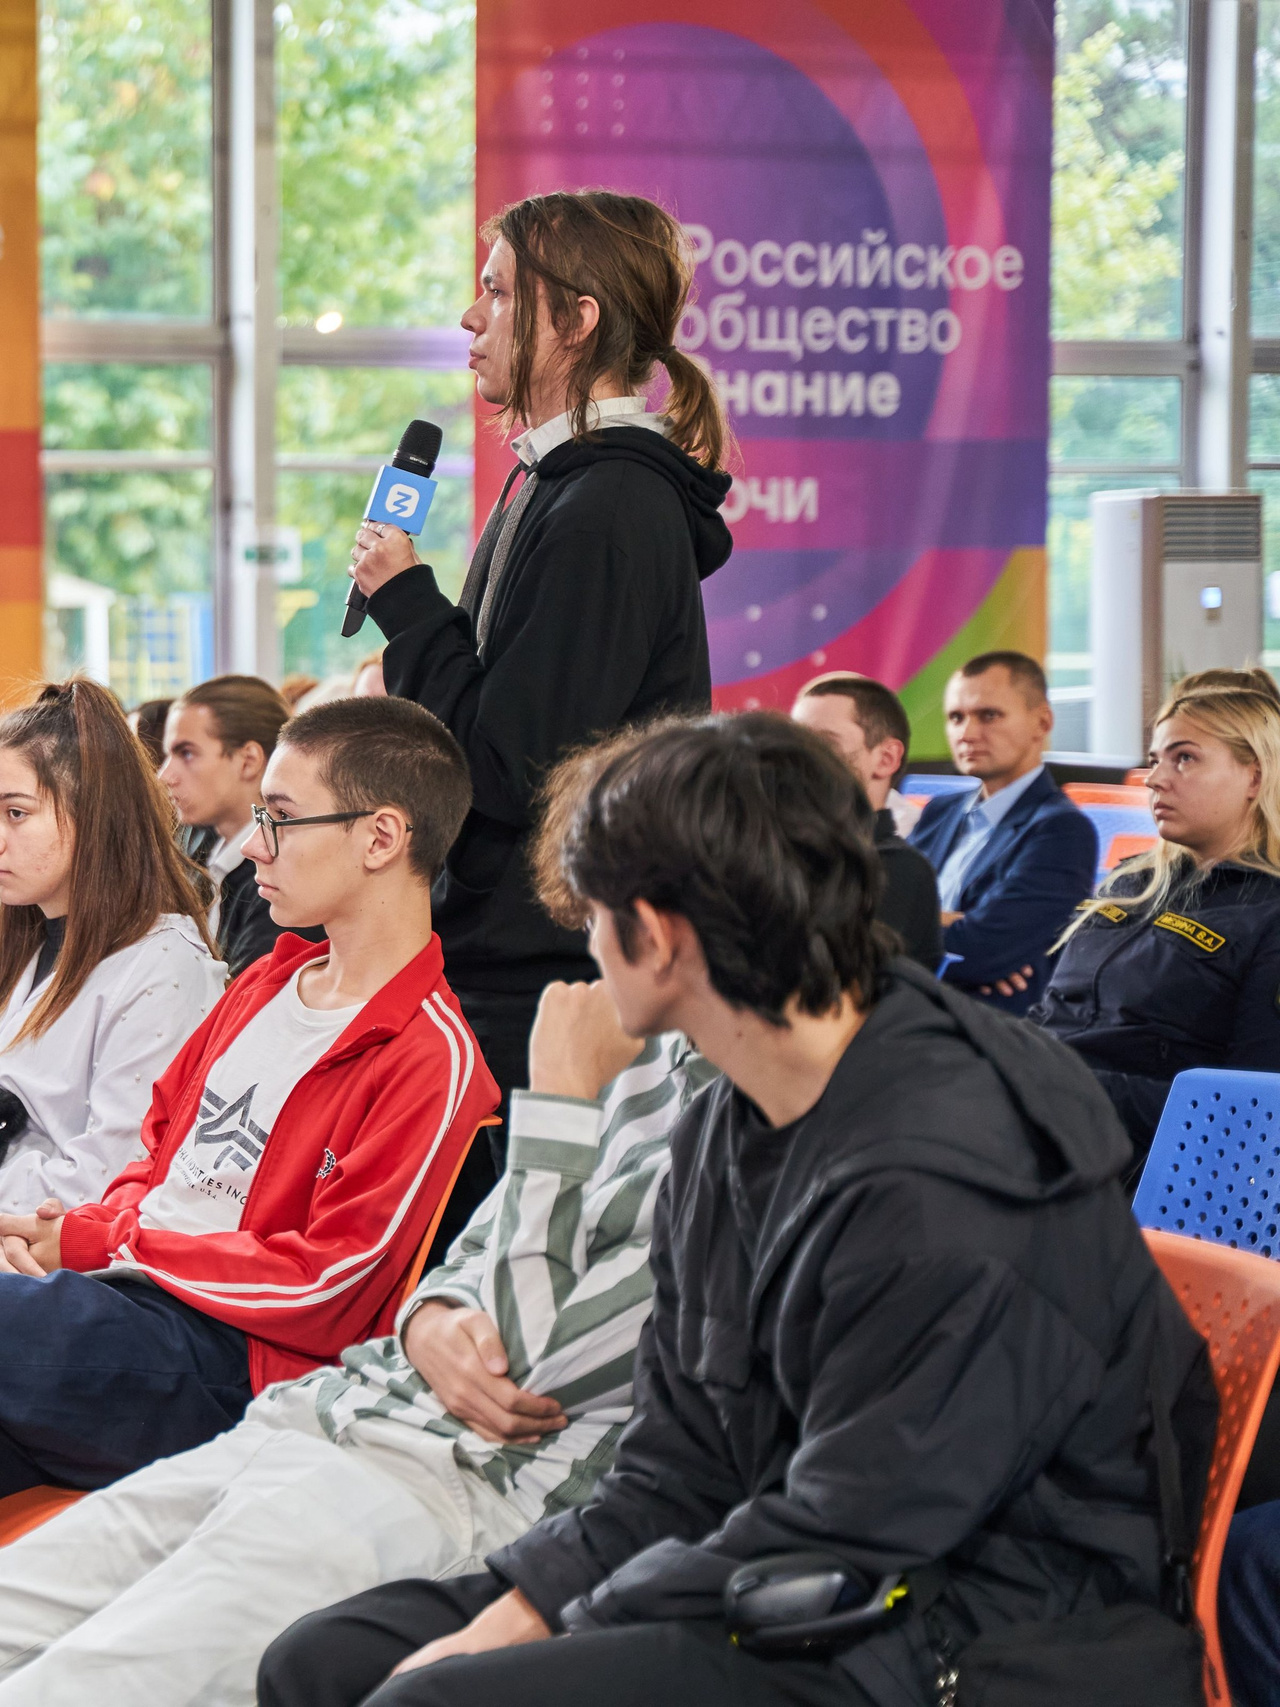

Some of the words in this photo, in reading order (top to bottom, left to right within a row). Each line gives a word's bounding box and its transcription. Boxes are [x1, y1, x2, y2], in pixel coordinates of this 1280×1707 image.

[678, 222, 1025, 291] Российское
[672, 292, 962, 362] общество
[696, 354, 901, 418] нание
[723, 476, 819, 524] очи
